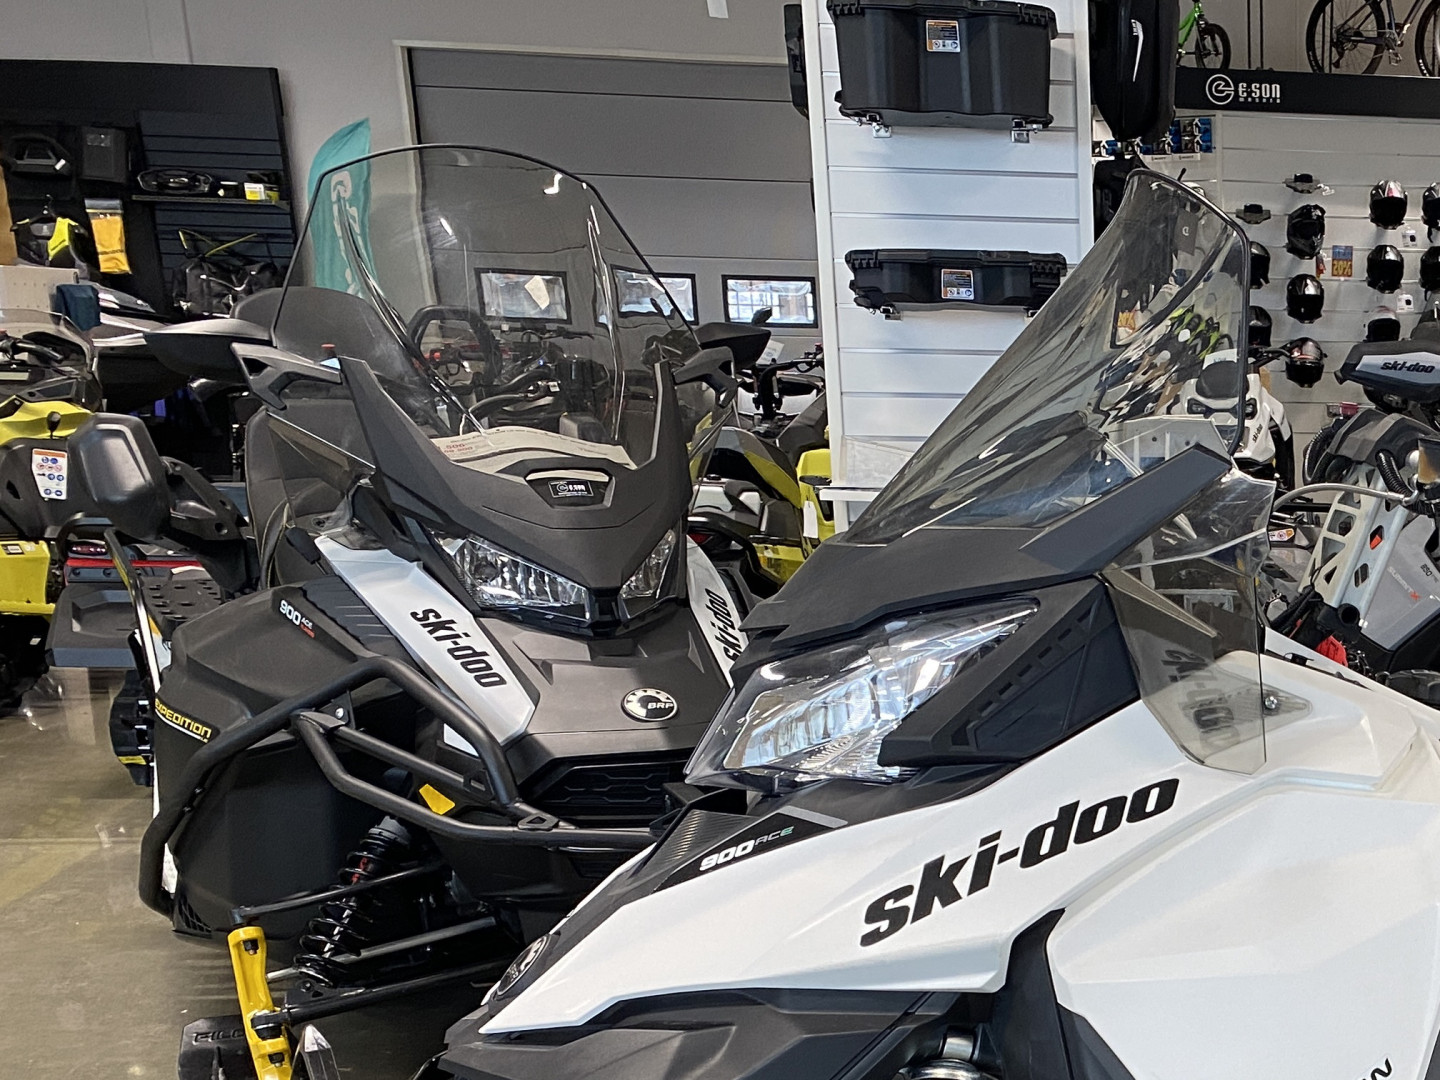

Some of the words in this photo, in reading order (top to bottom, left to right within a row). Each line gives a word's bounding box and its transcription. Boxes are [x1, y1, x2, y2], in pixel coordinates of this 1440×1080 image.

[1380, 360, 1436, 374] ski-doo
[280, 599, 302, 626] 900
[410, 608, 507, 688] ski-doo
[647, 701, 675, 710] BRP
[699, 839, 756, 872] 900
[859, 776, 1180, 949] ski-doo
